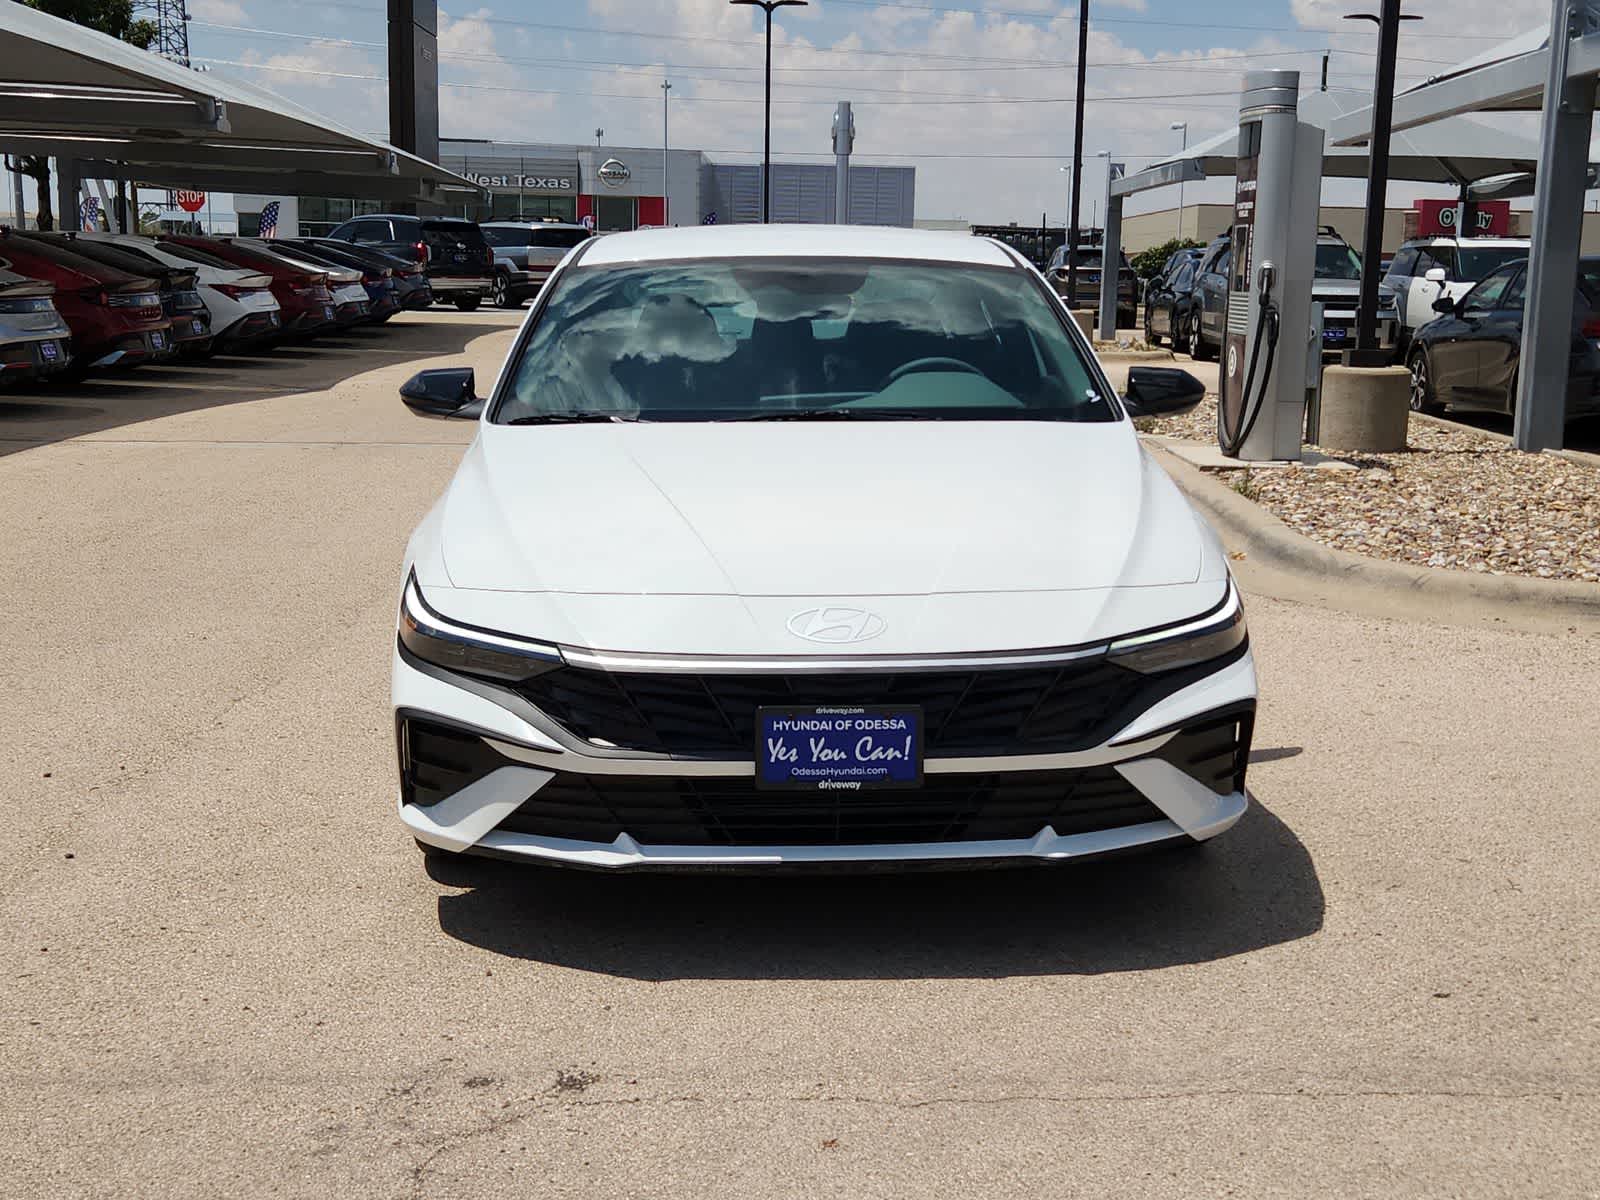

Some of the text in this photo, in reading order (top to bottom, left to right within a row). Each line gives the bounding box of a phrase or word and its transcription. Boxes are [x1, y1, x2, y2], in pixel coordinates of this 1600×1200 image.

[461, 173, 571, 189] West Texas
[178, 190, 204, 203] STOP
[815, 705, 865, 715] driveway.com
[773, 719, 906, 731] HYUNDAI OF ODESSA
[767, 735, 912, 763] Yes You Can!
[791, 767, 888, 777] OdessaHyundai.com
[818, 778, 862, 790] driveway
